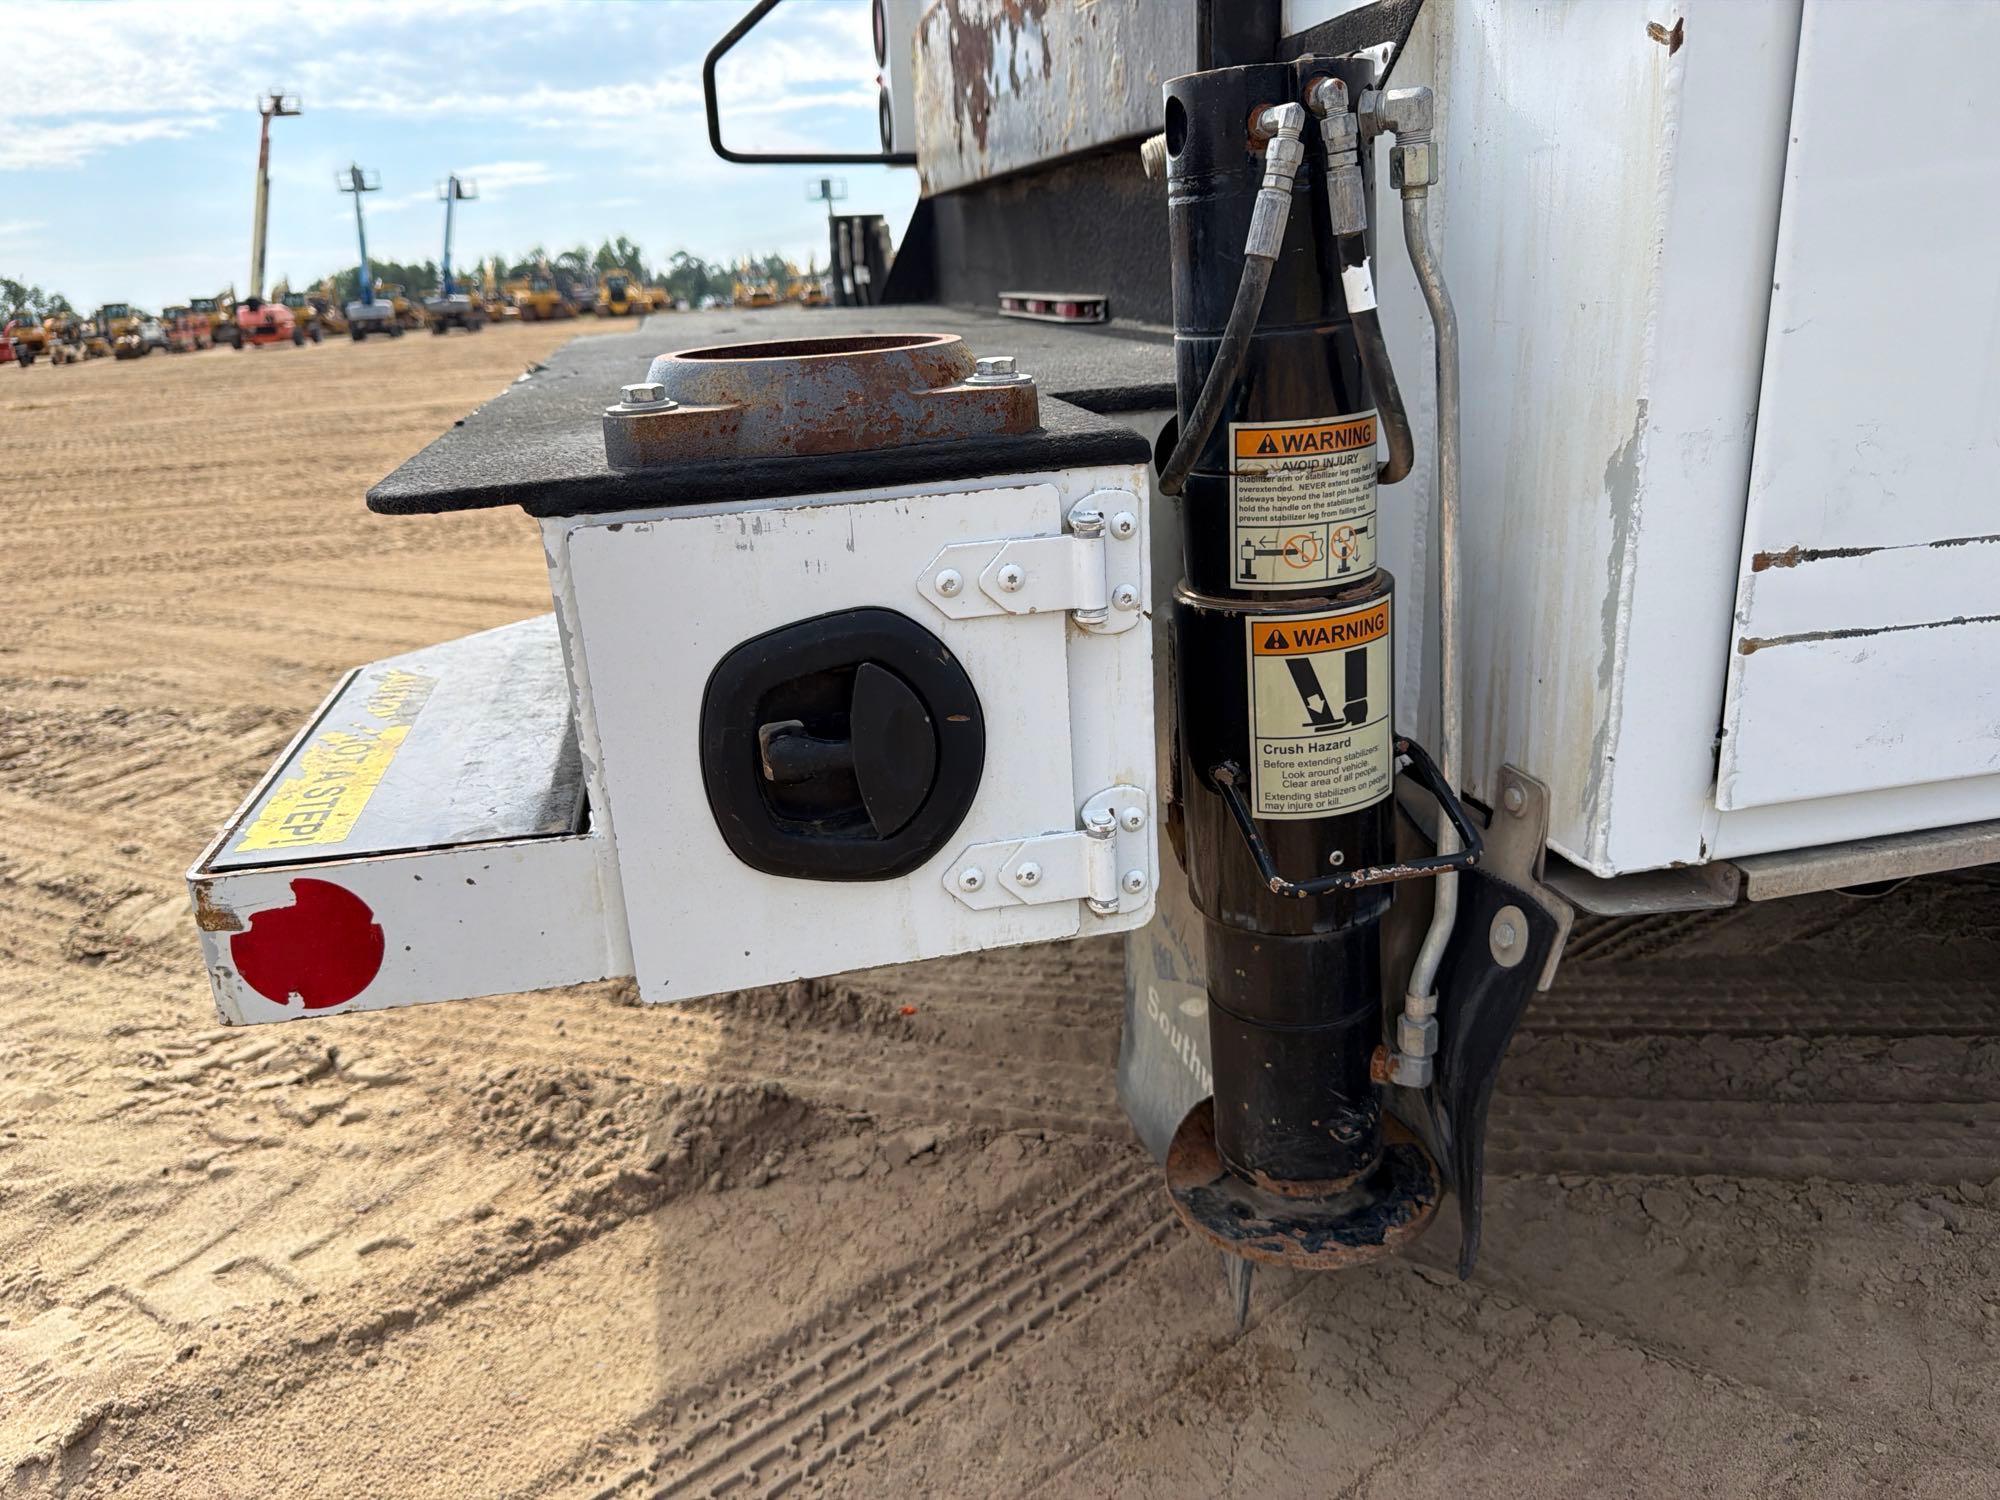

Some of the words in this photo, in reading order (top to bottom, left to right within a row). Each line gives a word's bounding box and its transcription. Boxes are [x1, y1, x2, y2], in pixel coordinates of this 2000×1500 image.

[1281, 424, 1371, 452] WARNING
[1281, 459, 1320, 472] AVOID
[1323, 453, 1358, 468] INJURY
[1305, 471, 1338, 480] stabilizer
[1340, 469, 1349, 477] leg
[1239, 485, 1294, 493] overextended.
[1299, 481, 1326, 491] NEVER
[1328, 478, 1349, 488] extend
[1239, 495, 1274, 504] sideways
[1277, 494, 1307, 503] beyond
[1322, 490, 1335, 498] last
[1337, 489, 1347, 498] pin
[1239, 515, 1268, 523] prevent
[1270, 513, 1306, 521] stabilizer
[1308, 512, 1319, 520] leg
[1321, 510, 1338, 518] from
[1339, 507, 1357, 515] falling
[1272, 503, 1299, 512] handle
[1293, 613, 1384, 648] WARNING
[1263, 744, 1304, 755] Crush
[1308, 736, 1351, 753] Hazard
[1263, 760, 1295, 769] Before
[1297, 756, 1342, 768] extending
[312, 770, 356, 783] A
[1282, 771, 1305, 779] Look
[1308, 767, 1340, 778] around
[1282, 780, 1308, 788] Clear
[1310, 778, 1331, 787] area
[1333, 775, 1342, 784] of
[1344, 772, 1353, 782] all
[1264, 792, 1312, 802] Extending
[1314, 786, 1356, 799] stabilizers
[1358, 782, 1367, 791] on
[1264, 802, 1285, 811] may
[1288, 800, 1313, 811] injure
[1328, 797, 1341, 806] kill.
[268, 786, 347, 844] STEP!
